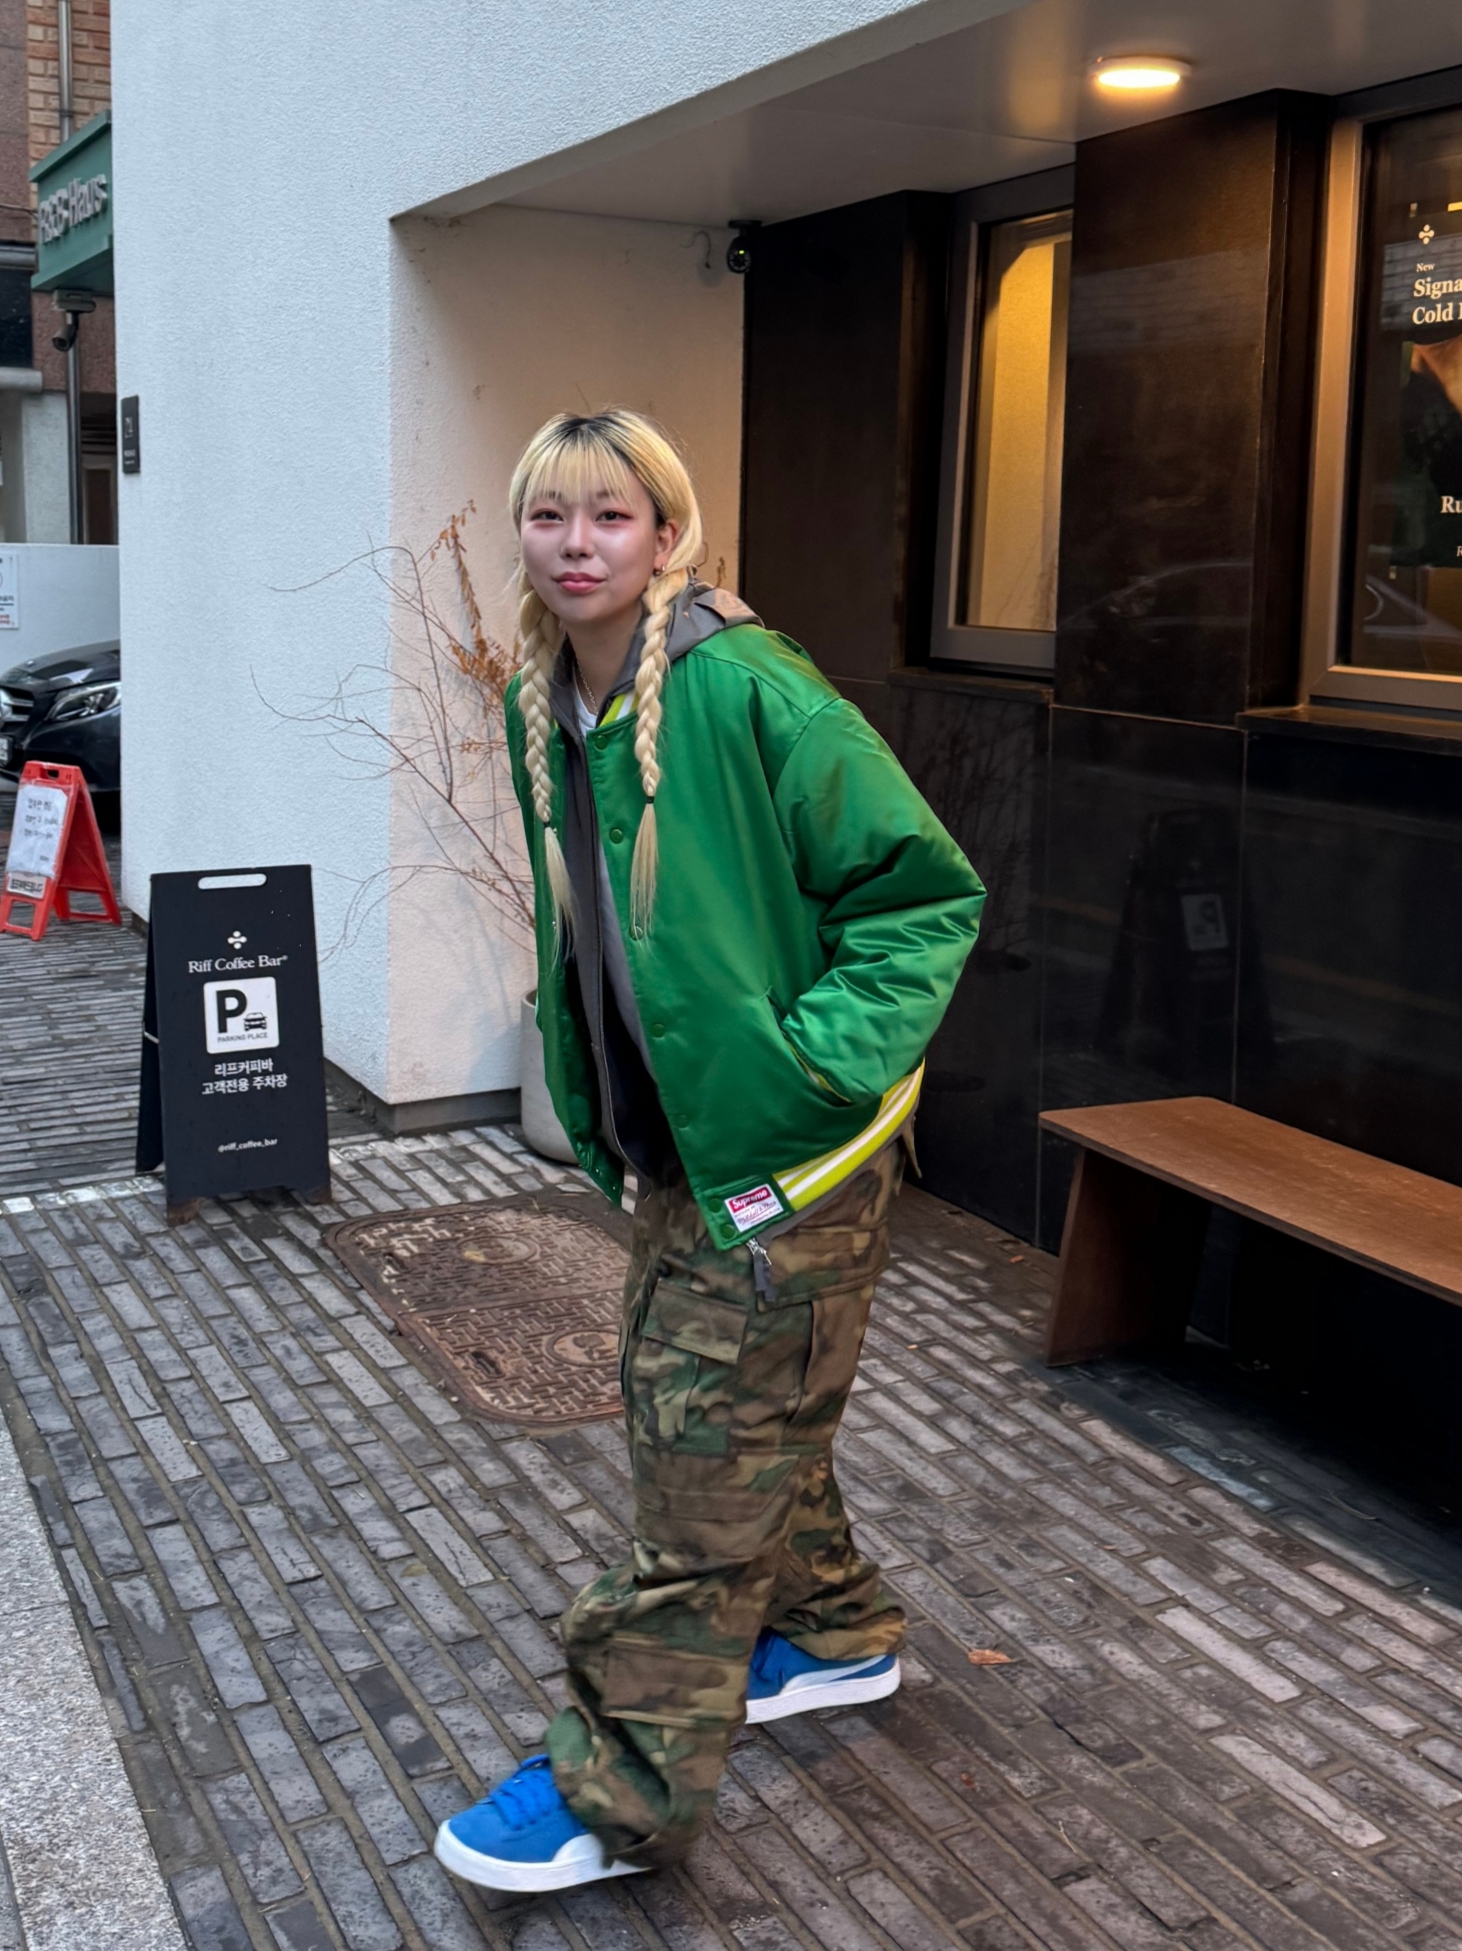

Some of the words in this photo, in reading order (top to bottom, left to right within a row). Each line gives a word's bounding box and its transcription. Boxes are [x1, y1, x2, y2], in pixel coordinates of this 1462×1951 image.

[1416, 263, 1435, 272] New
[1412, 302, 1453, 325] Cold
[188, 960, 212, 973] Riff
[215, 957, 255, 971] Coffee
[216, 989, 248, 1034] P
[217, 1034, 246, 1043] PARKING
[247, 1032, 268, 1041] PLACE
[214, 1058, 274, 1077] 리프커피바
[202, 1078, 249, 1095] 고객전용
[252, 1073, 288, 1090] 주차장
